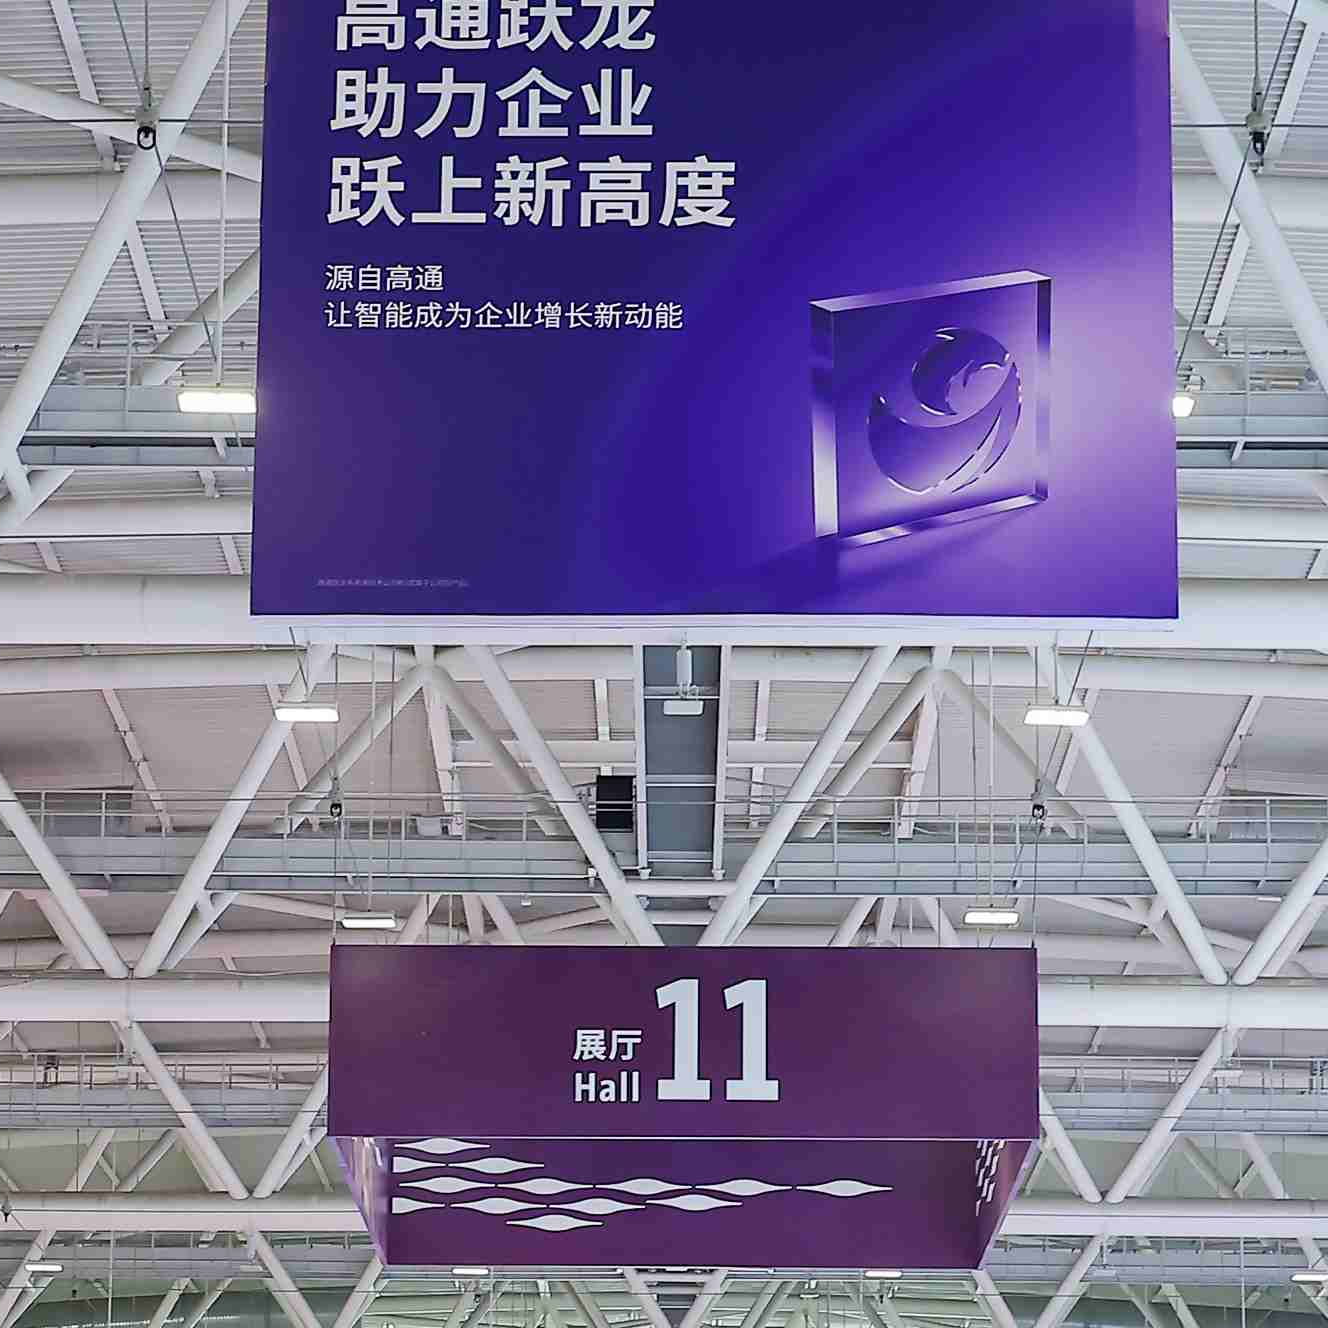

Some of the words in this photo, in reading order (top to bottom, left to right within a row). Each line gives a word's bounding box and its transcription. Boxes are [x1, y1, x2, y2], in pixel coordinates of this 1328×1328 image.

[337, 0, 656, 50] 高通跃龙
[330, 67, 653, 138] 助力企业
[327, 155, 736, 227] 跃上新高度
[325, 265, 444, 291] 源自高通
[324, 302, 683, 329] 让智能成为企业增长新动能
[573, 1028, 642, 1061] 展厅
[575, 1072, 640, 1102] Hall
[656, 978, 779, 1102] 11
